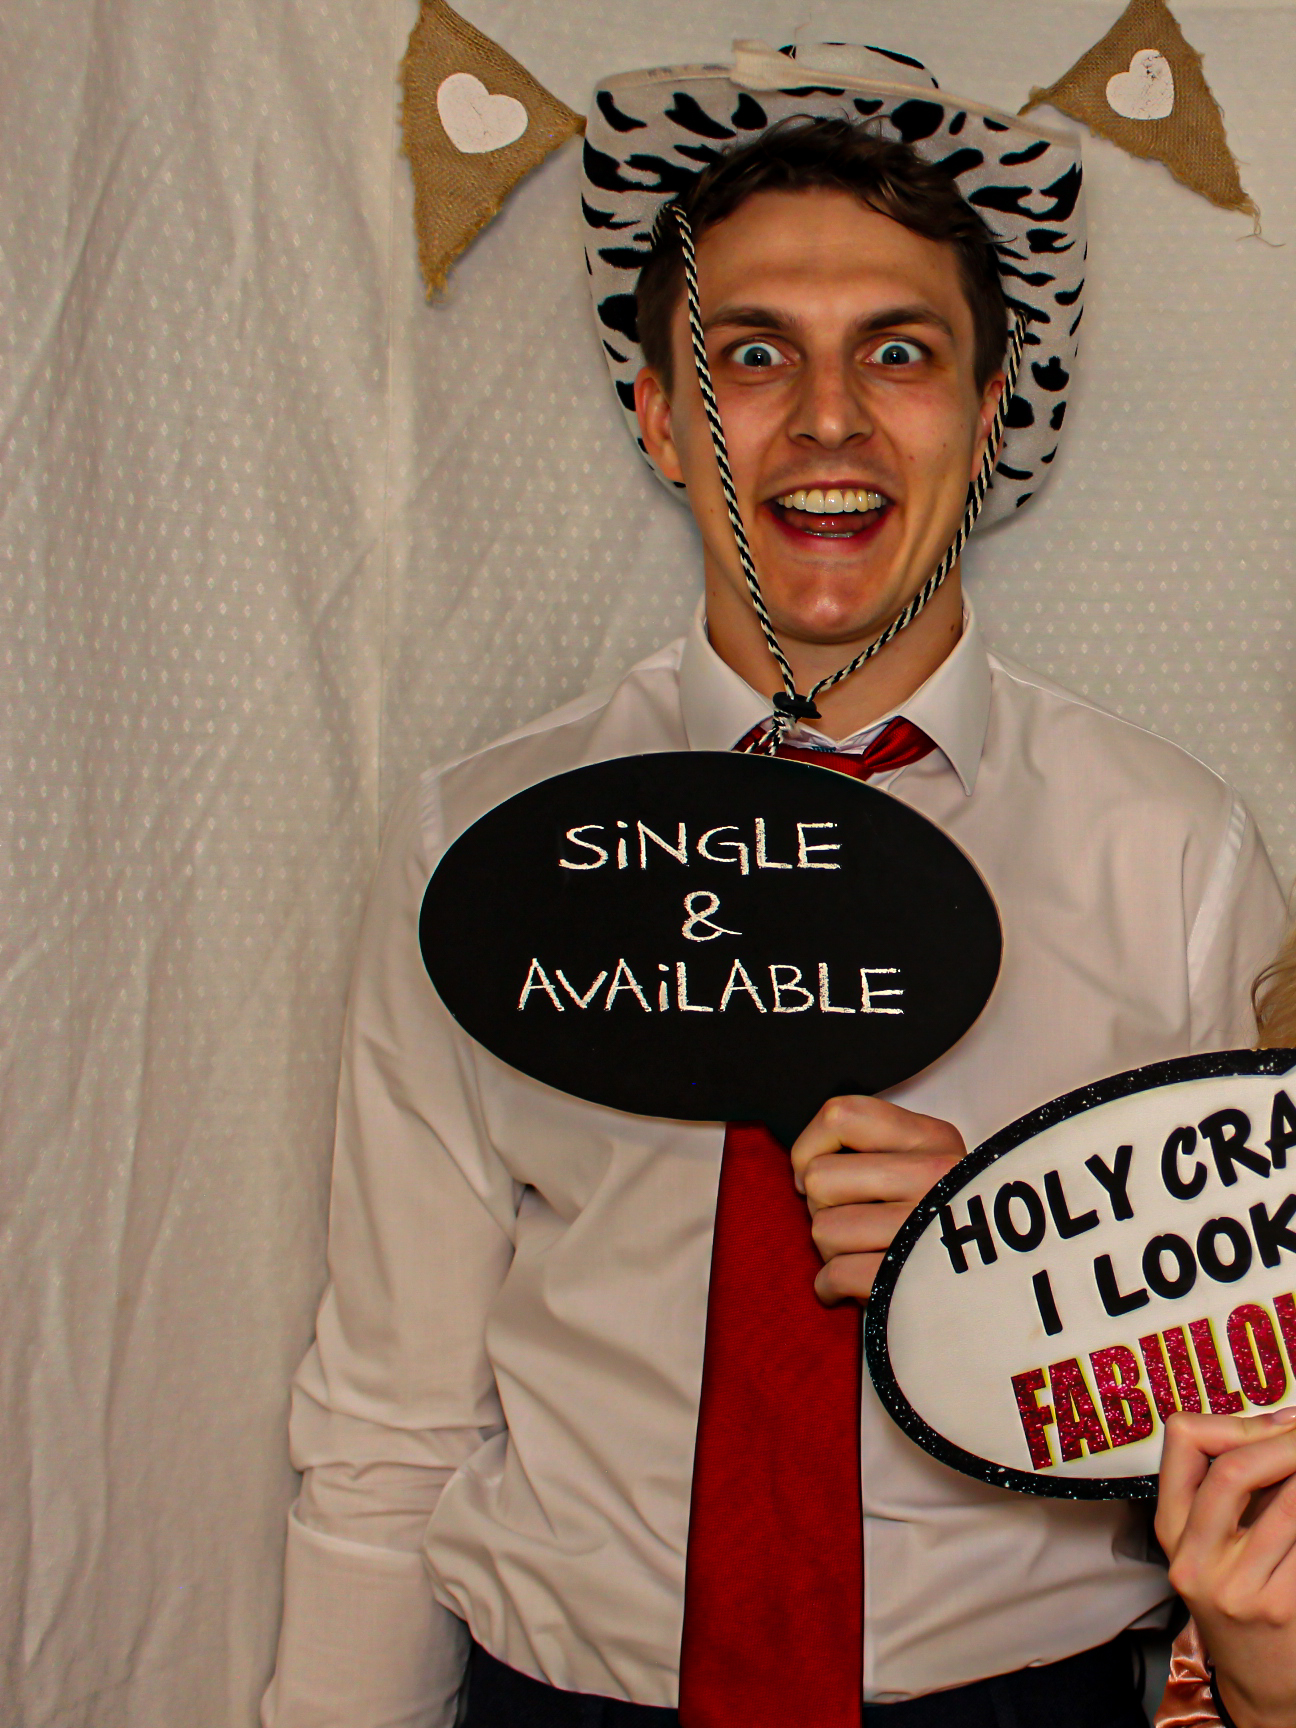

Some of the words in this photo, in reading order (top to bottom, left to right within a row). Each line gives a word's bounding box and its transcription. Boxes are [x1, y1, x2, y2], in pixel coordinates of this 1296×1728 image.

[681, 890, 743, 942] &
[939, 1145, 1134, 1274] HOLY
[1031, 1269, 1063, 1336] I
